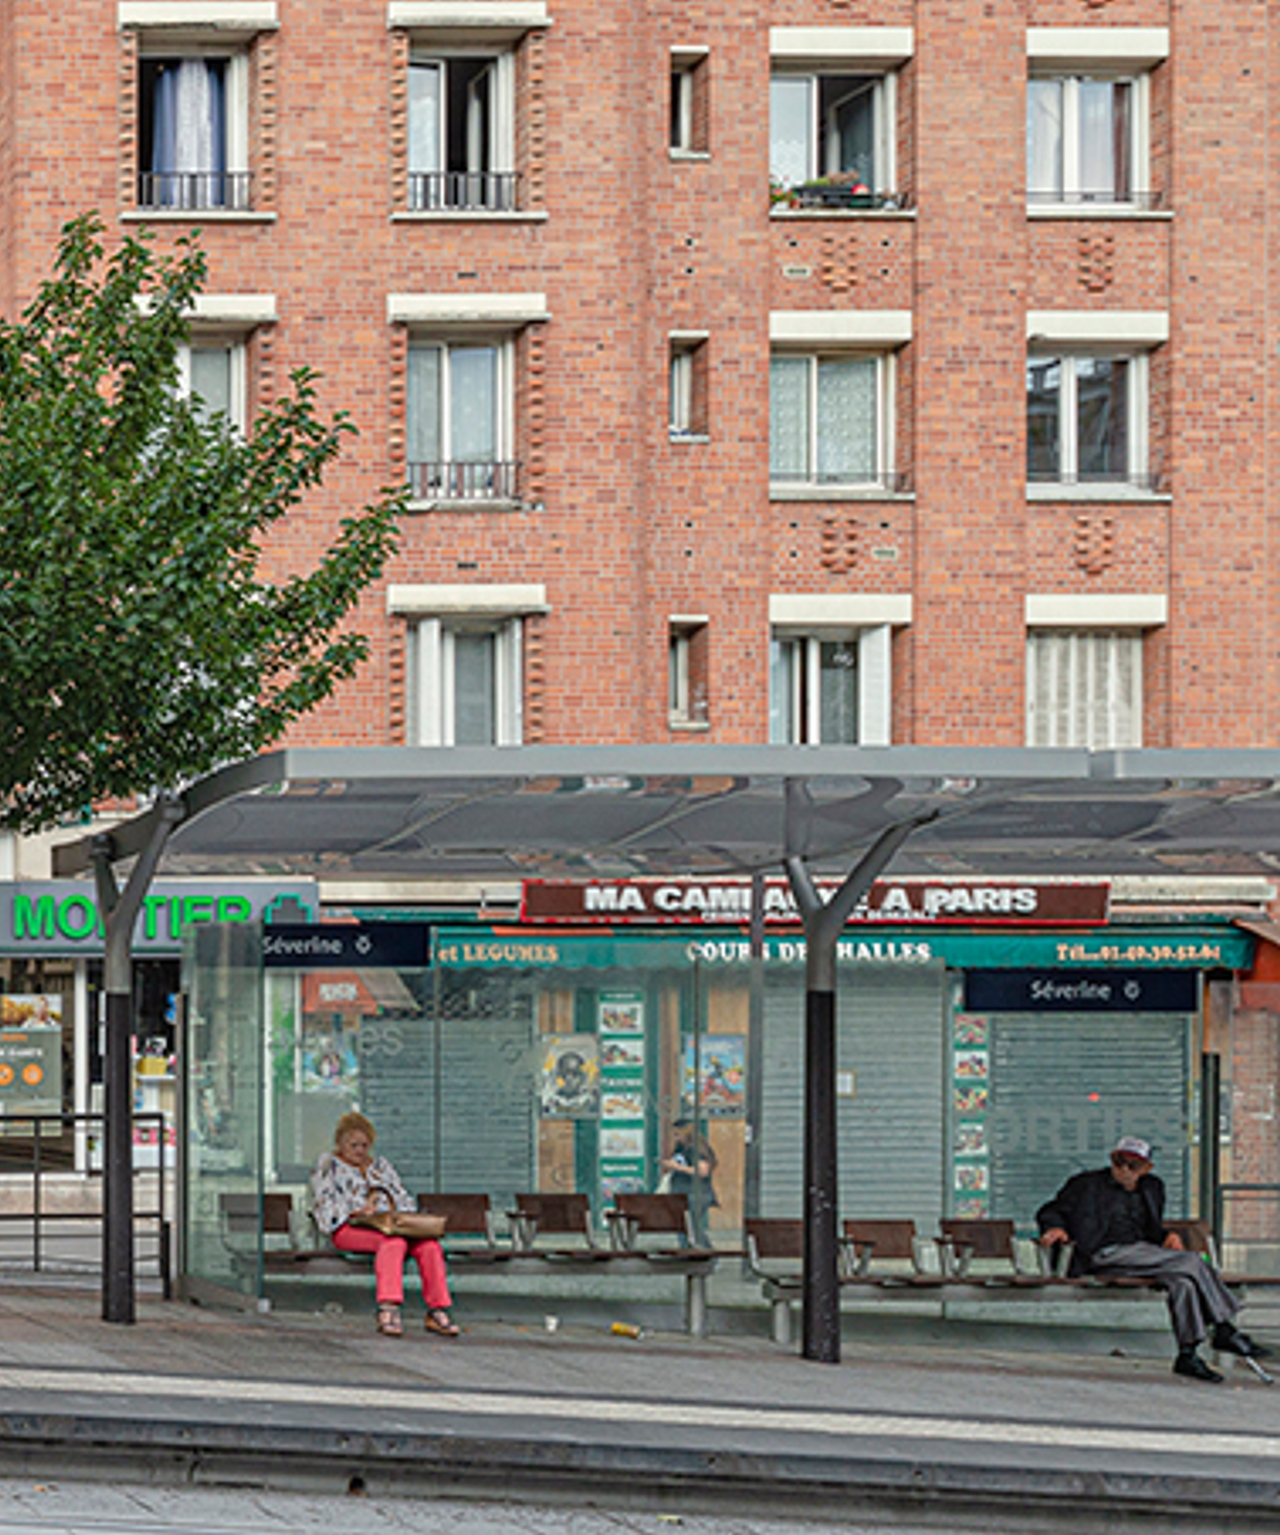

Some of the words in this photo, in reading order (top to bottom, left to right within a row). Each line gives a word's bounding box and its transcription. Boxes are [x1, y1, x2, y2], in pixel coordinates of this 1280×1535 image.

[584, 887, 646, 911] MA
[924, 887, 1038, 913] PARIS
[13, 894, 252, 939] MOTIER
[264, 936, 342, 954] Séverine
[438, 945, 458, 962] et
[463, 943, 558, 962] LEGUMES
[836, 941, 931, 961] HALLES
[1030, 979, 1111, 999] Séverine
